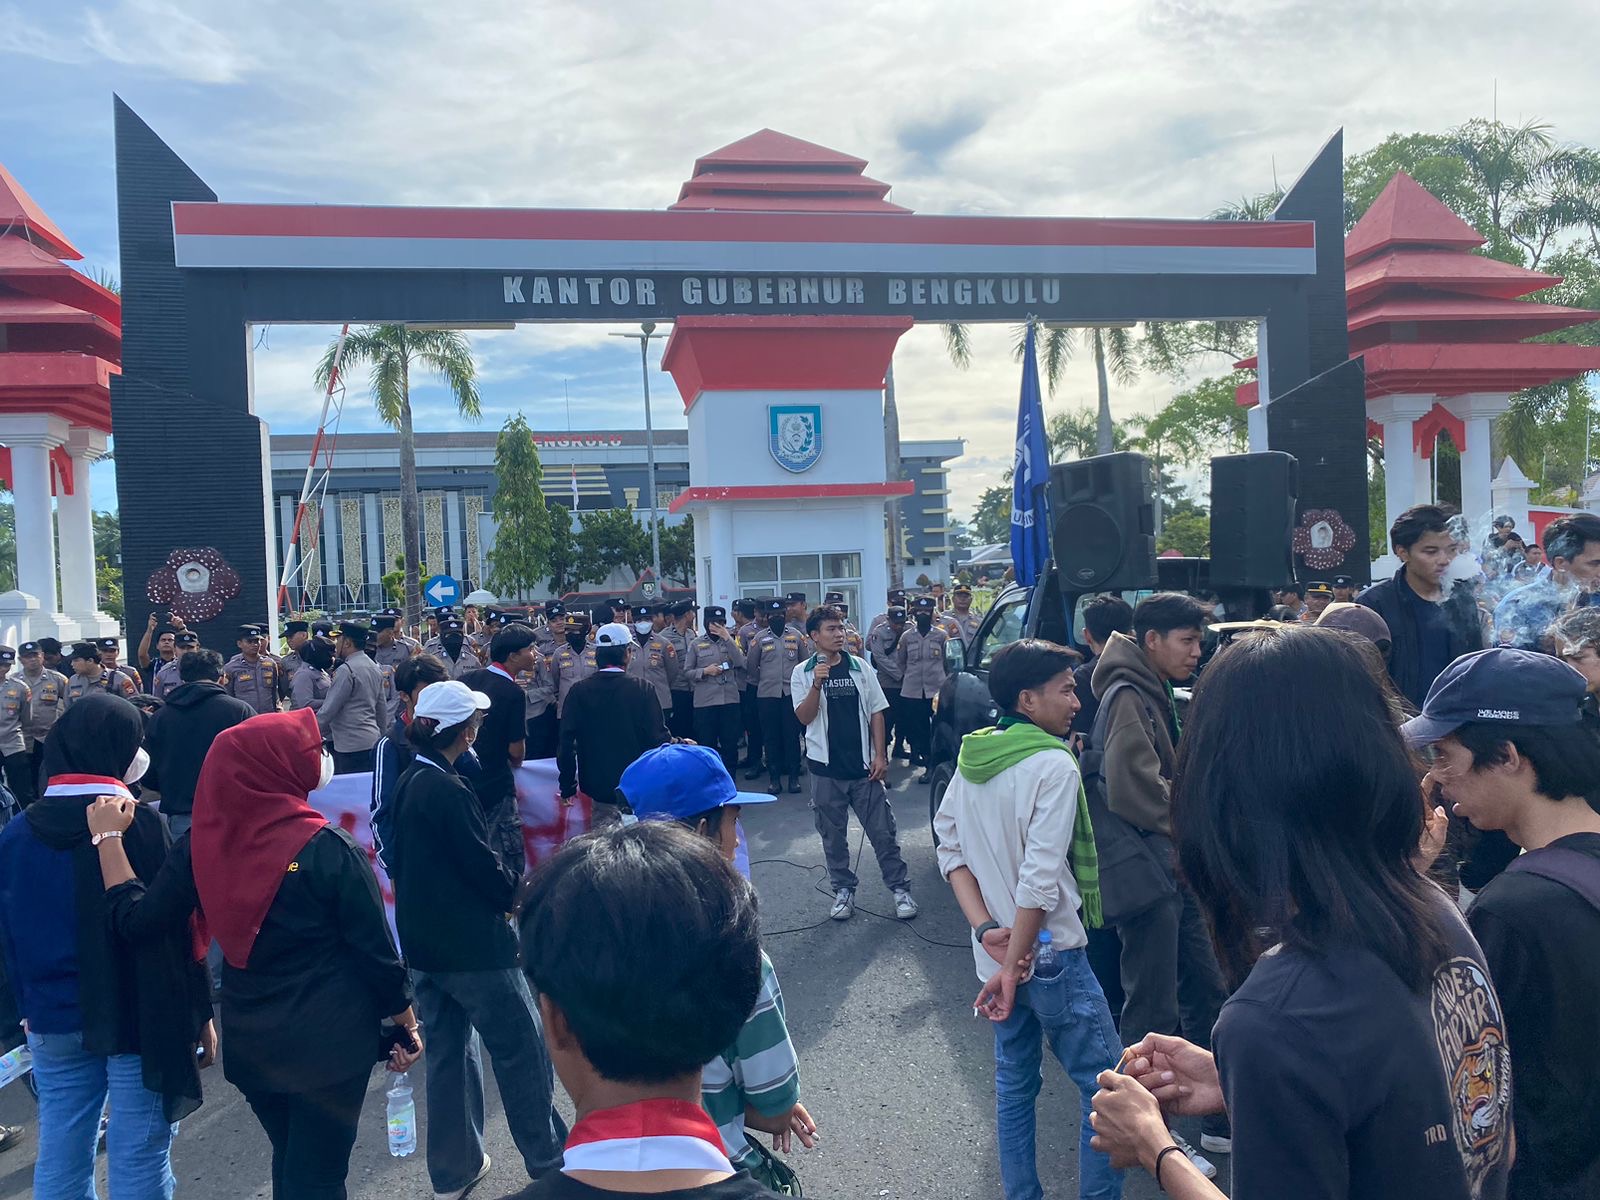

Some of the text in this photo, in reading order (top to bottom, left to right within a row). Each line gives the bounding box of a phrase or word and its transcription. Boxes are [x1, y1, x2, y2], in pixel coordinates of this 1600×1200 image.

[503, 276, 1061, 305] KANTOR GUBERNUR BENGKULU
[532, 434, 623, 447] ENGKULU
[826, 678, 855, 687] ASURE
